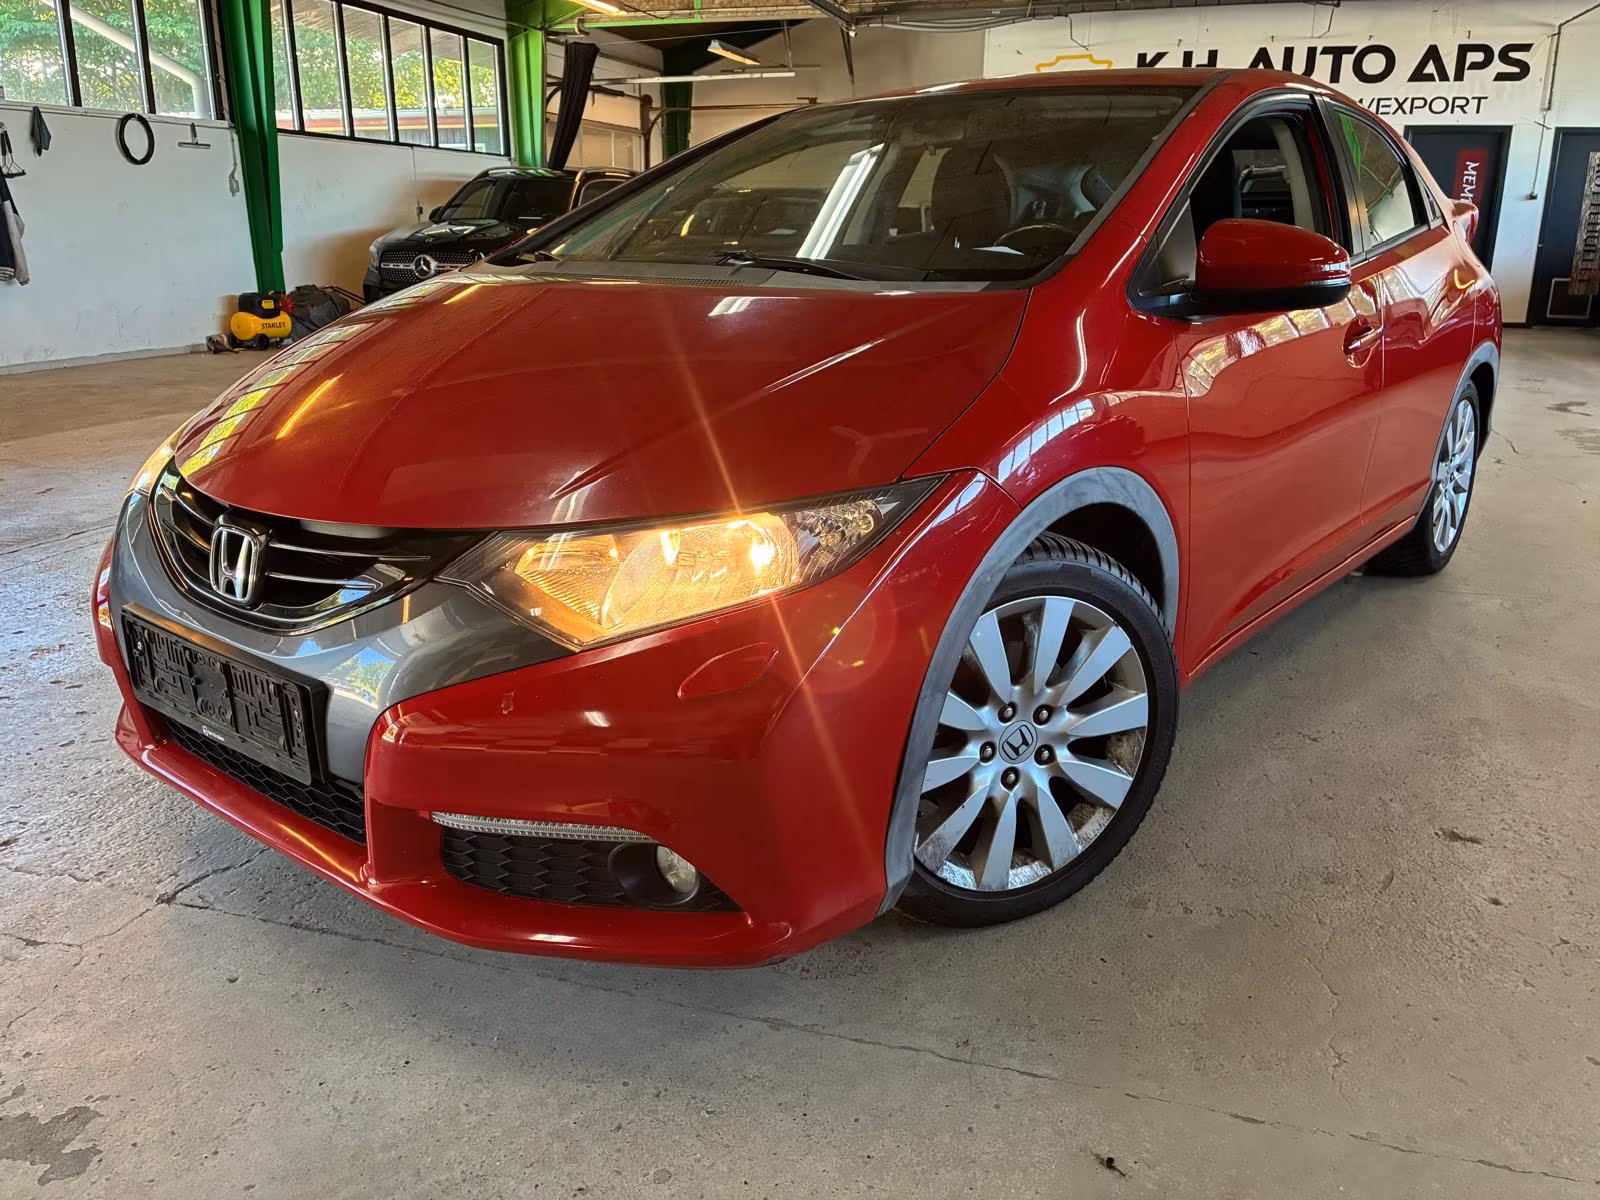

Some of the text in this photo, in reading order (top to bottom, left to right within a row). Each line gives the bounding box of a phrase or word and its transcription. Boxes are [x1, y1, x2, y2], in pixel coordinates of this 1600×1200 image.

[1248, 44, 1396, 84] AUTO
[1407, 43, 1534, 82] APS
[261, 321, 286, 330] STANLEY
